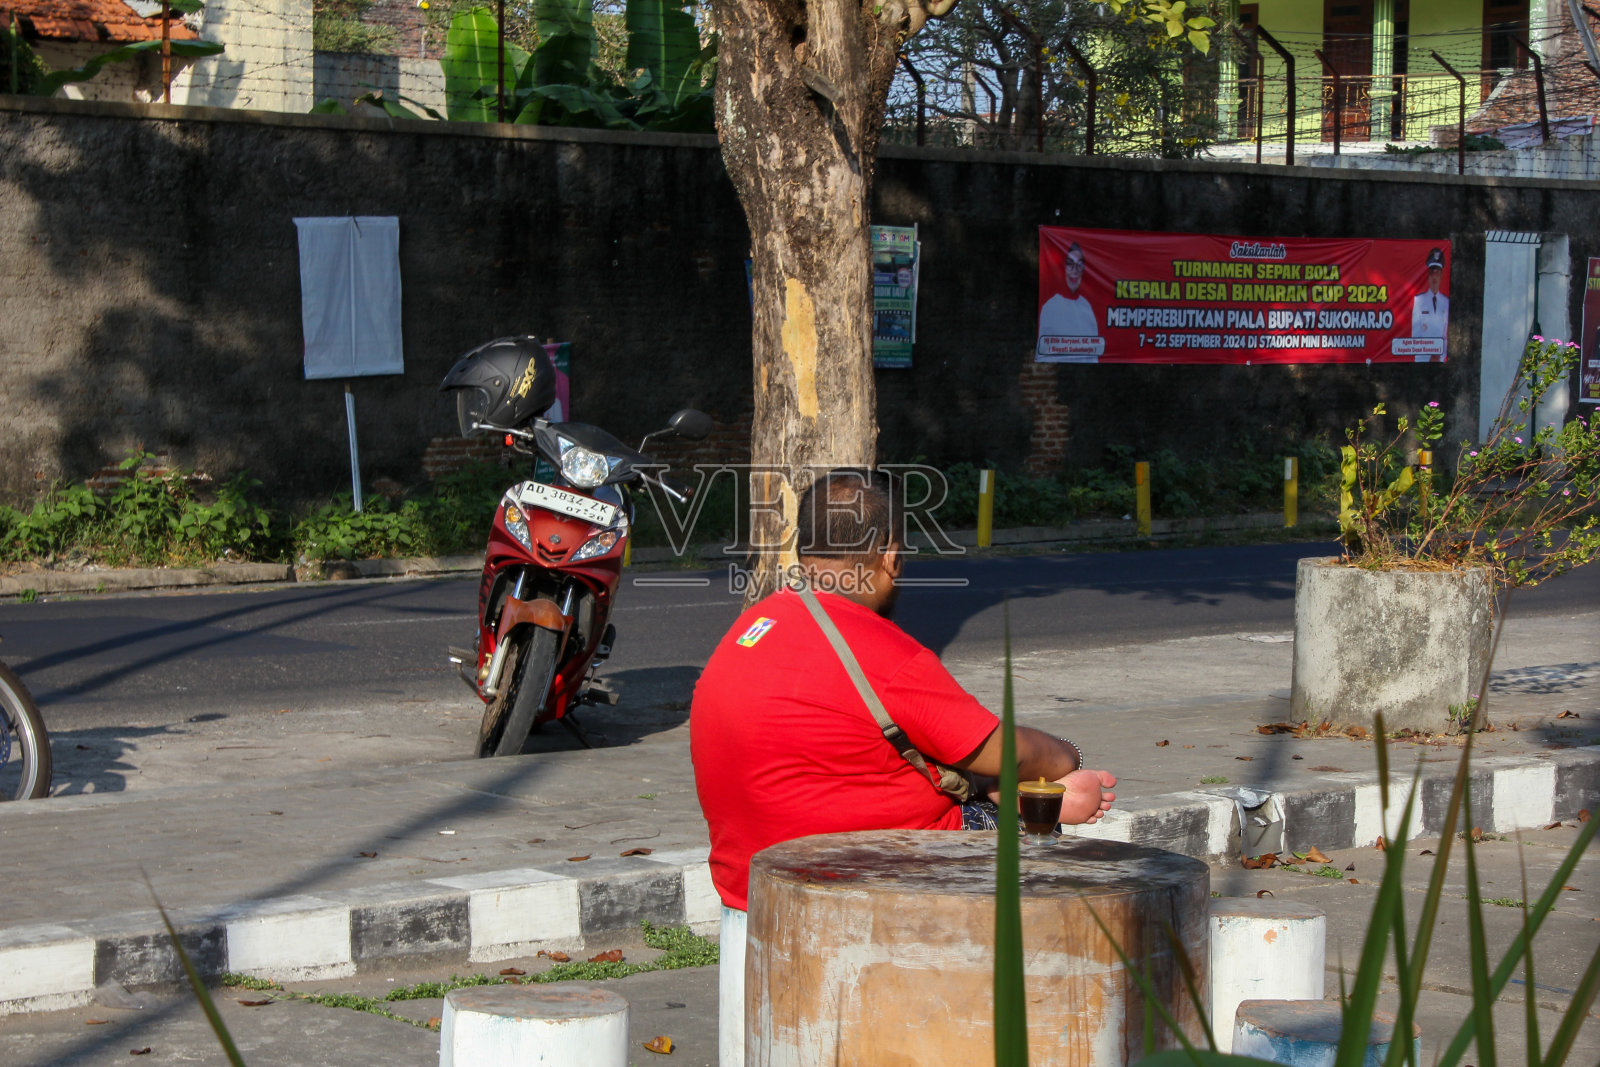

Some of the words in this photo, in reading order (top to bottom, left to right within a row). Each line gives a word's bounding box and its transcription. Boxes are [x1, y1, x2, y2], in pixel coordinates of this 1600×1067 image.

[1230, 241, 1286, 259] Saksikanlah
[1172, 261, 1253, 278] TURNAMEN
[1256, 264, 1301, 280] SEPAK
[1304, 265, 1340, 280] BOLA
[1116, 281, 1181, 300] KEPALA
[1185, 282, 1227, 300] DESA
[1232, 284, 1307, 302] BANARAN
[1311, 285, 1344, 302] CUP
[1347, 286, 1388, 302] 2024
[1107, 307, 1224, 328] MEMPEREBUTKAN
[1227, 310, 1265, 329] PIALA
[1268, 311, 1316, 329] BUPATI
[1317, 311, 1393, 329] SUKOHARJO
[1139, 334, 1146, 348] 7
[1155, 334, 1167, 348] 22
[1169, 334, 1221, 348] SEPTEMBER
[1223, 335, 1246, 348] 2024
[1247, 335, 1257, 348] DI
[1259, 335, 1300, 348] STADION
[1301, 335, 1320, 348] MINI
[1321, 335, 1365, 348] BANARAN
[526, 483, 545, 495] AD
[550, 489, 583, 506] 3834
[590, 501, 609, 514] ZK
